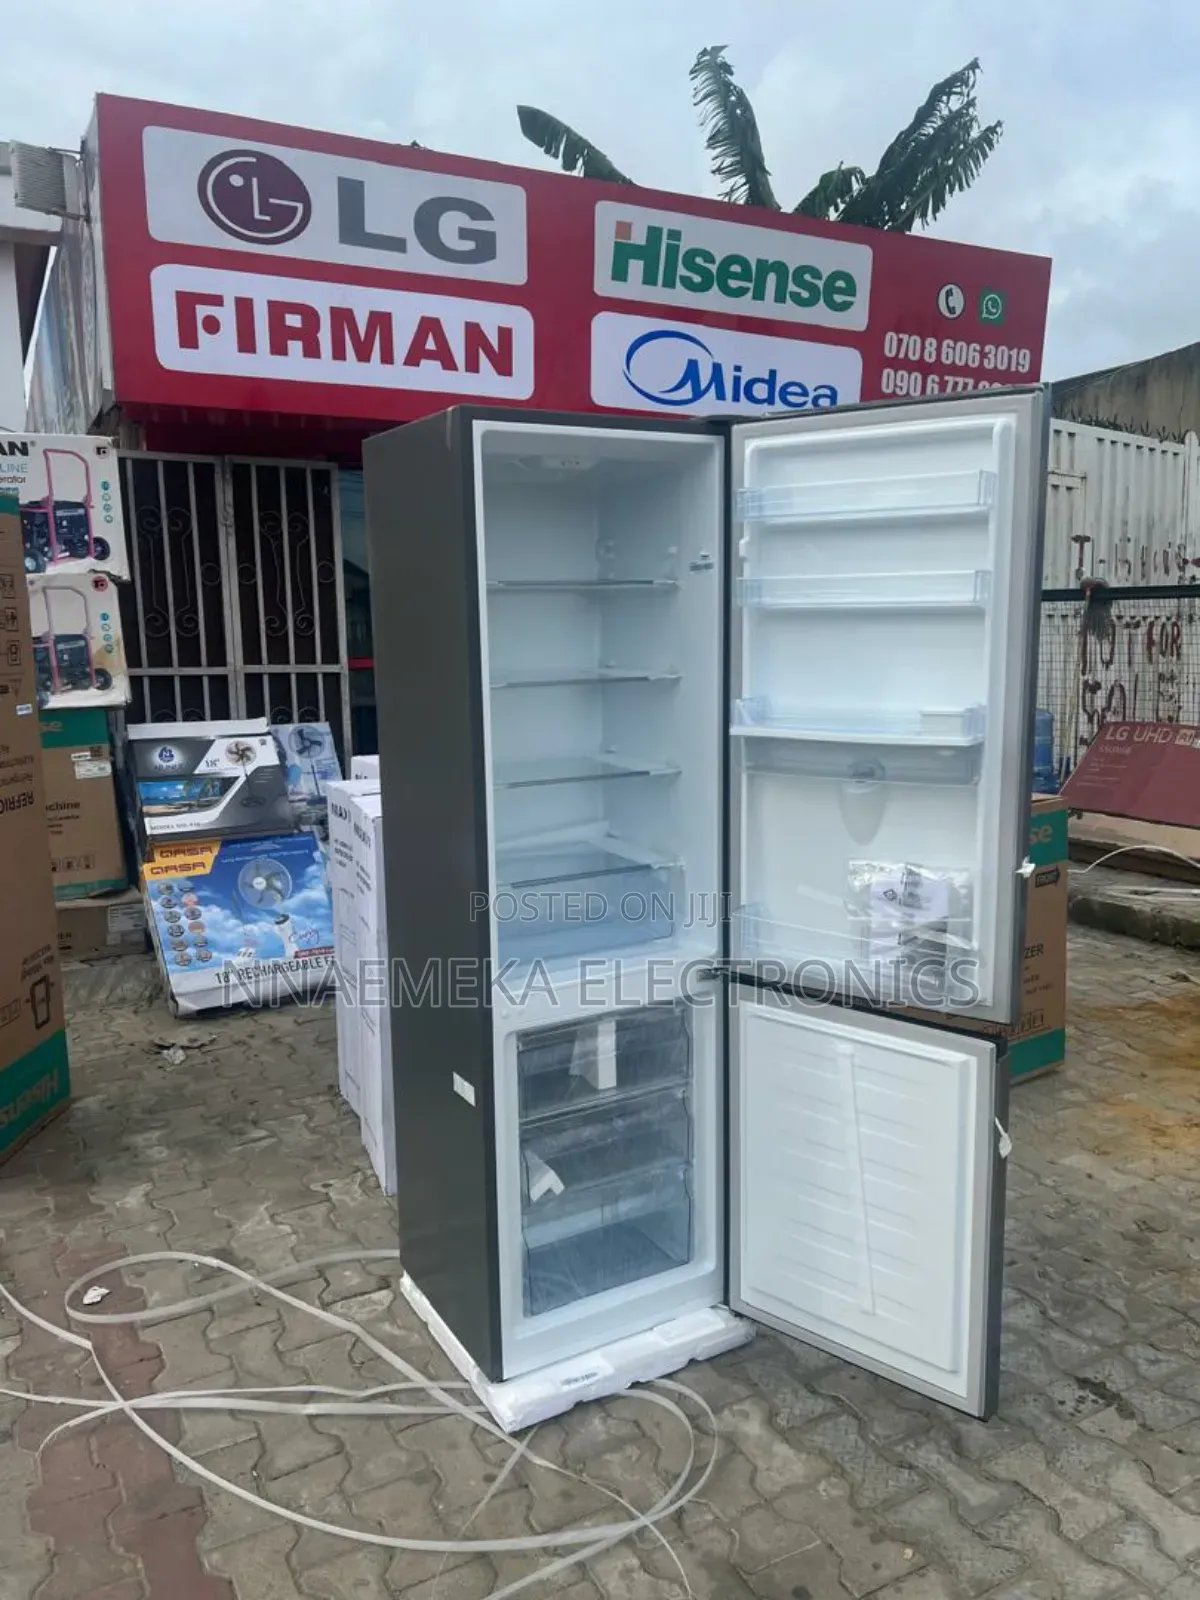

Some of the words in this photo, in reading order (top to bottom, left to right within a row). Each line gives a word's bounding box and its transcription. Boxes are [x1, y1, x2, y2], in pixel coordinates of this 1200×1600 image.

[337, 176, 497, 265] LG
[611, 220, 857, 313] Hisense
[175, 290, 514, 378] FIRMAN
[884, 331, 921, 361] 070
[941, 339, 980, 368] 606
[983, 344, 1031, 373] 3019
[659, 357, 839, 408] Midea
[881, 368, 922, 397] 090
[1104, 725, 1131, 741] LG
[1133, 726, 1174, 743] UHD
[150, 861, 206, 876] QASA
